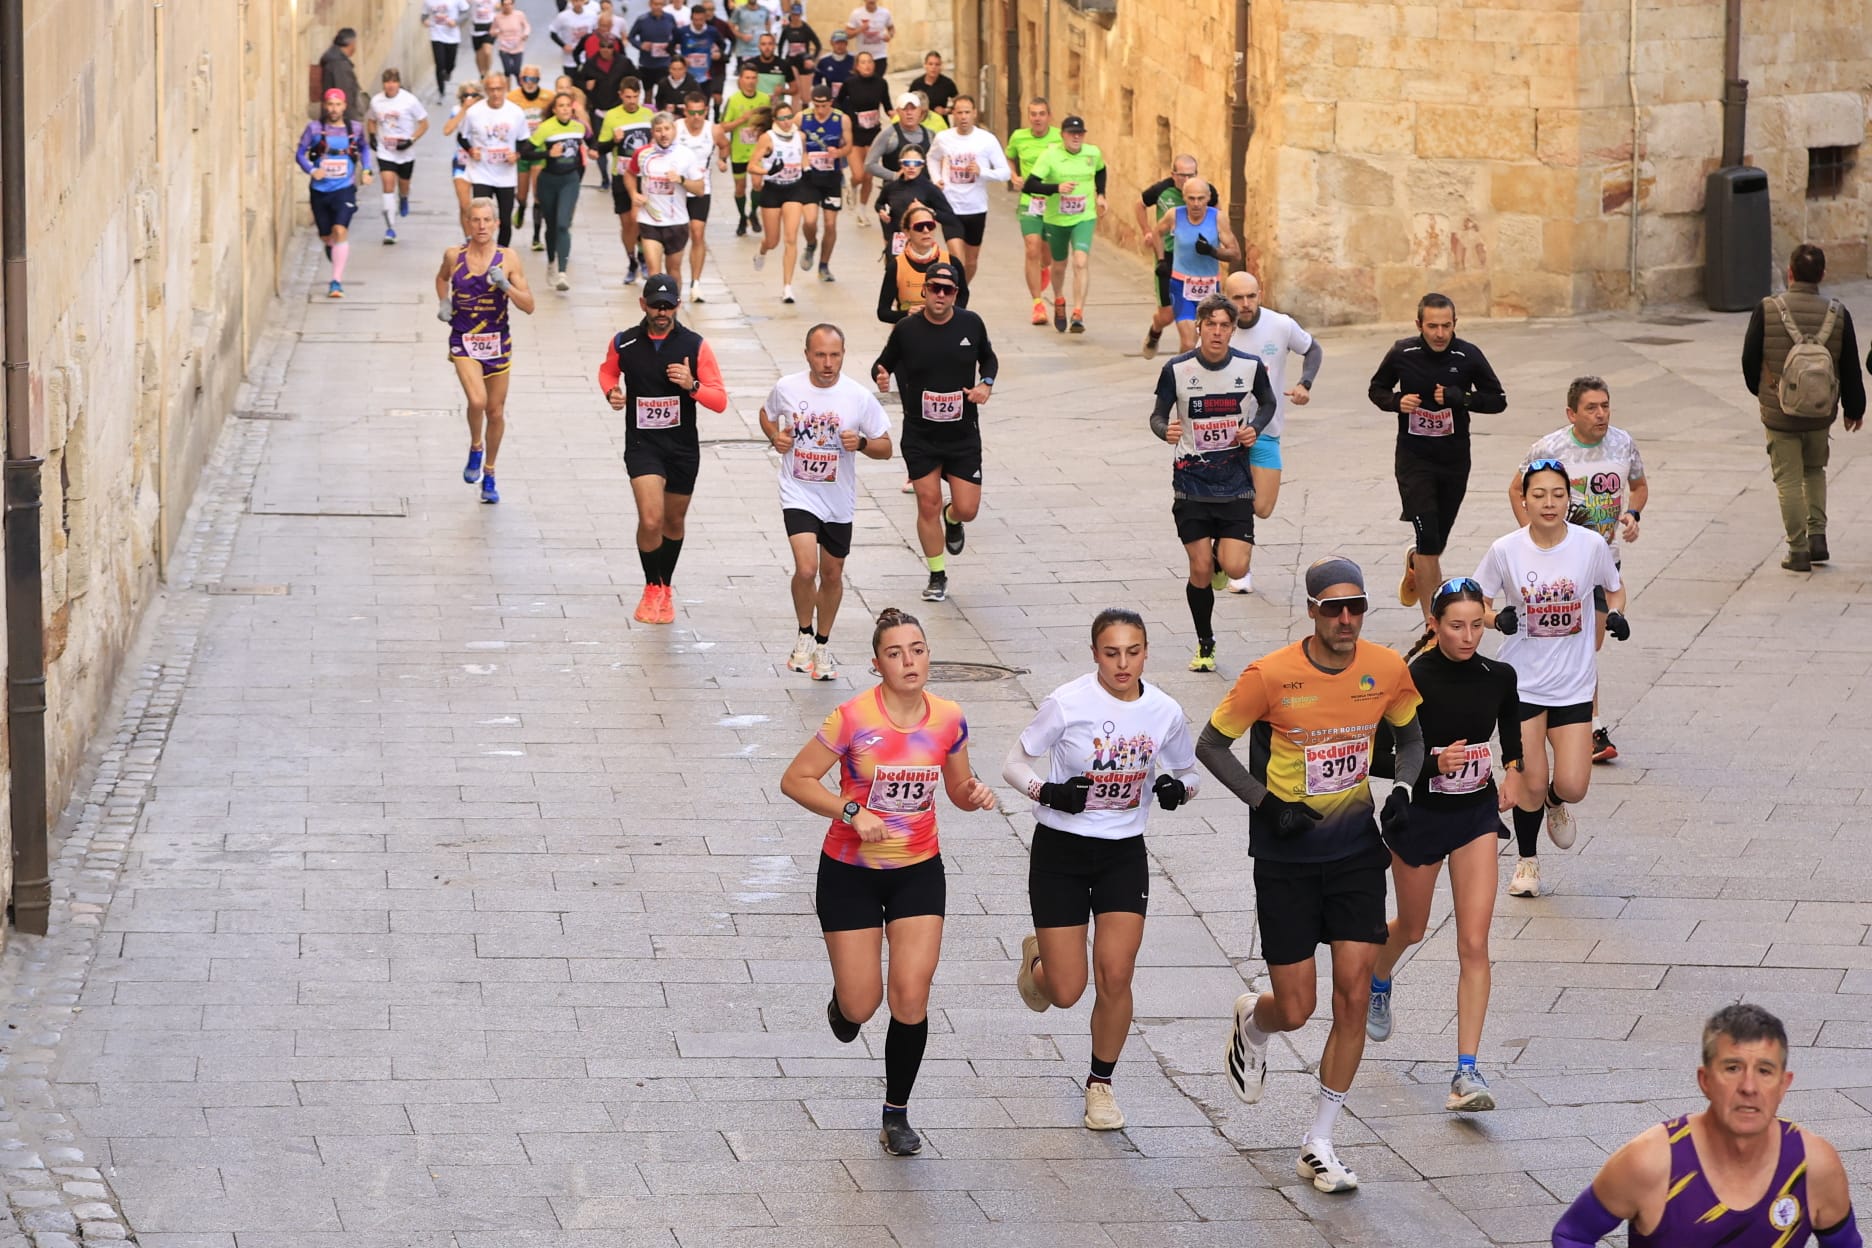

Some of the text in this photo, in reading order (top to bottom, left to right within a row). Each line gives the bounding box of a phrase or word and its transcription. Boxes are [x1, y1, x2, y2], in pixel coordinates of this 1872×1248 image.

[1191, 285, 1209, 294] 662
[472, 342, 492, 351] 204
[638, 399, 679, 408] bedunia
[924, 392, 962, 403] bedunia
[646, 408, 671, 419] 296
[932, 402, 954, 413] 126
[1192, 419, 1237, 431] bedunia
[1418, 417, 1443, 429] 233
[1203, 429, 1228, 442] 651
[794, 448, 838, 462] bedunia
[802, 460, 828, 473] 147
[1526, 601, 1581, 614] bedunia
[1538, 612, 1572, 627] 480
[1306, 741, 1368, 761] bedunia
[1322, 754, 1357, 778] 370
[876, 768, 939, 781] bedunia
[886, 782, 925, 799] 313
[1094, 782, 1132, 799] 382
